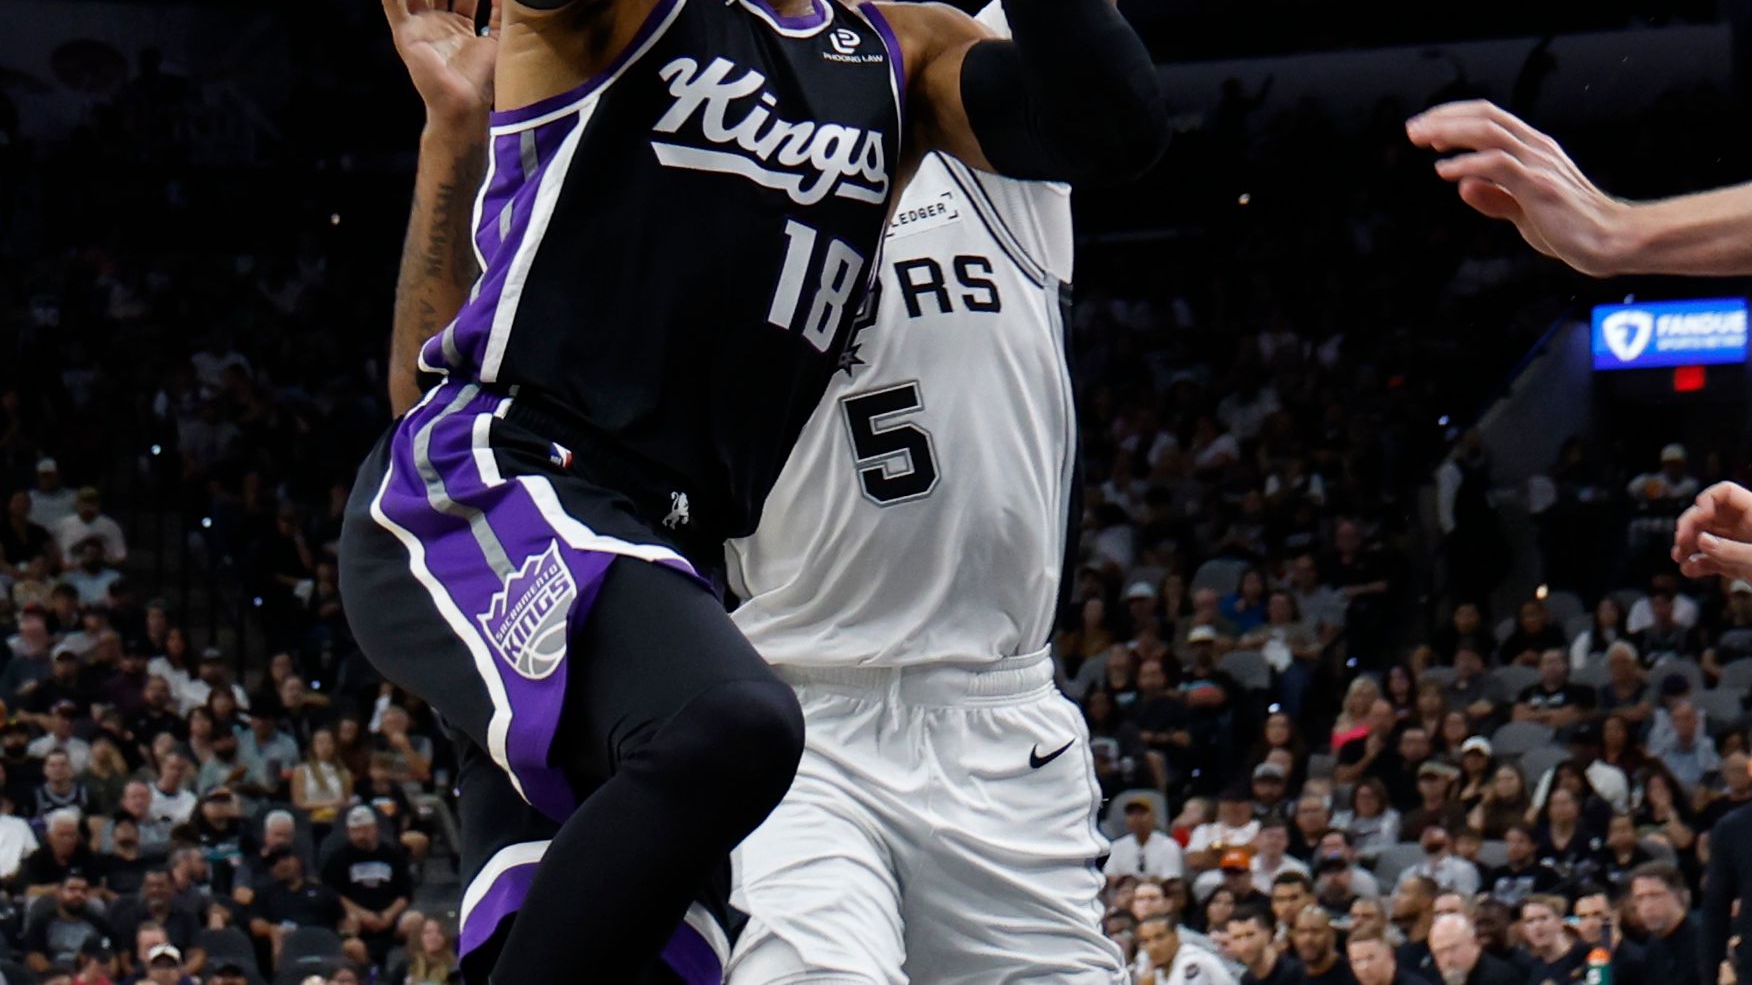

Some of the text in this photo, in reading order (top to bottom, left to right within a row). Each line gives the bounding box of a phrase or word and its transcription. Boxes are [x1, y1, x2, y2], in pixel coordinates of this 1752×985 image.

[862, 55, 884, 63] LAW
[651, 56, 889, 205] Kings
[766, 216, 865, 355] 18
[1656, 309, 1748, 337] FANDUE
[841, 379, 942, 508] 5
[496, 564, 558, 642] SACRAMENTO
[503, 574, 572, 665] KINGS
